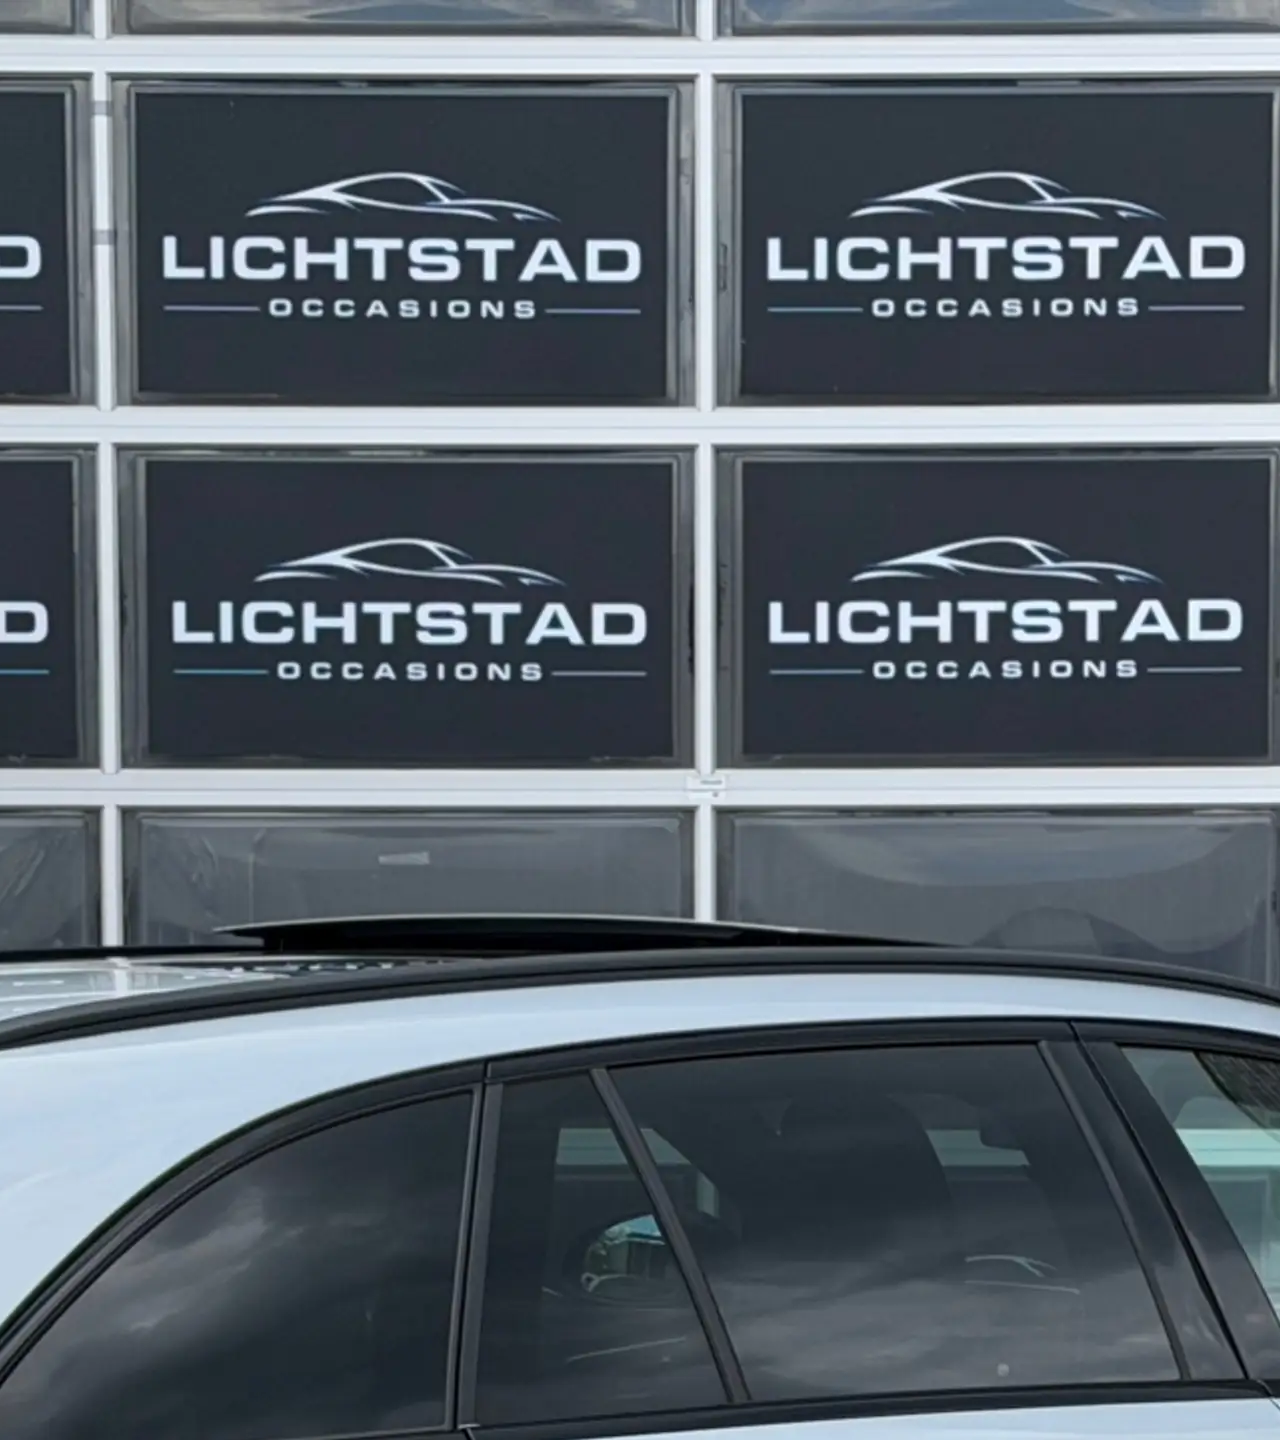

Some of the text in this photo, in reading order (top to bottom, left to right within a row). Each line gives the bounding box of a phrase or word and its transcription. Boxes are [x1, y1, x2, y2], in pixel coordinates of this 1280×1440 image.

[163, 235, 641, 282] LICHTSTAD
[767, 235, 1246, 281] LICHTSTAD
[269, 298, 535, 319] OCCASIONS
[872, 297, 1139, 317] OCCASIONS
[172, 600, 647, 645] LICHTSTAD
[769, 598, 1243, 644] LICHTSTAD
[277, 661, 542, 681] OCCASIONS
[873, 659, 1137, 679] OCCASIONS
